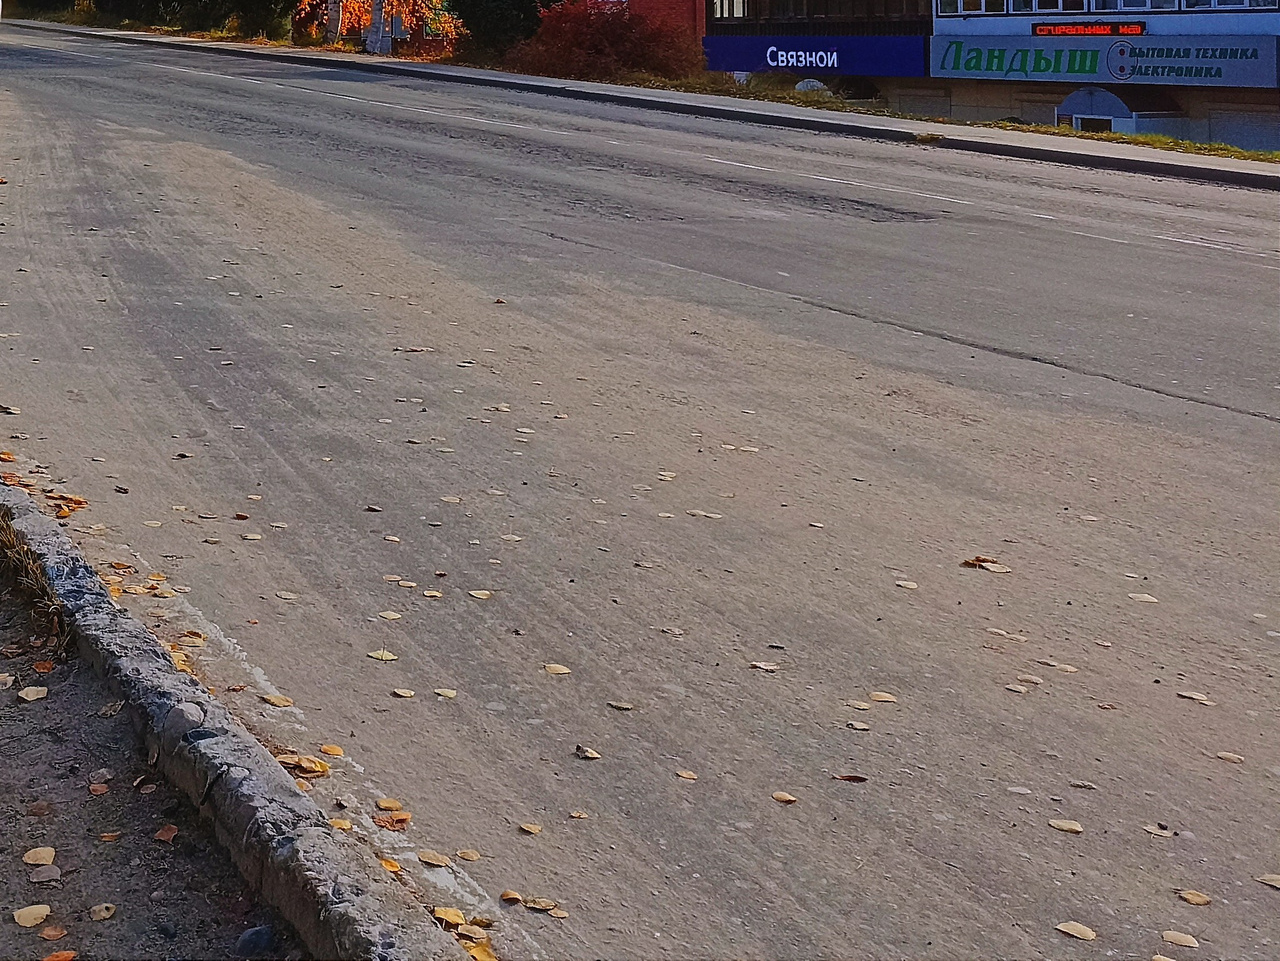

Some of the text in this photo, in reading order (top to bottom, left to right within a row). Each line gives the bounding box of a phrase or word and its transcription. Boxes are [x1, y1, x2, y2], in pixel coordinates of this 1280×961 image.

[766, 46, 838, 68] Связной
[940, 40, 1100, 78] Ландыш
[1128, 46, 1260, 60] БЫТОВАЯ ТЕХНИКА
[1128, 65, 1223, 78] ЭЛЕКТРОНИКА
